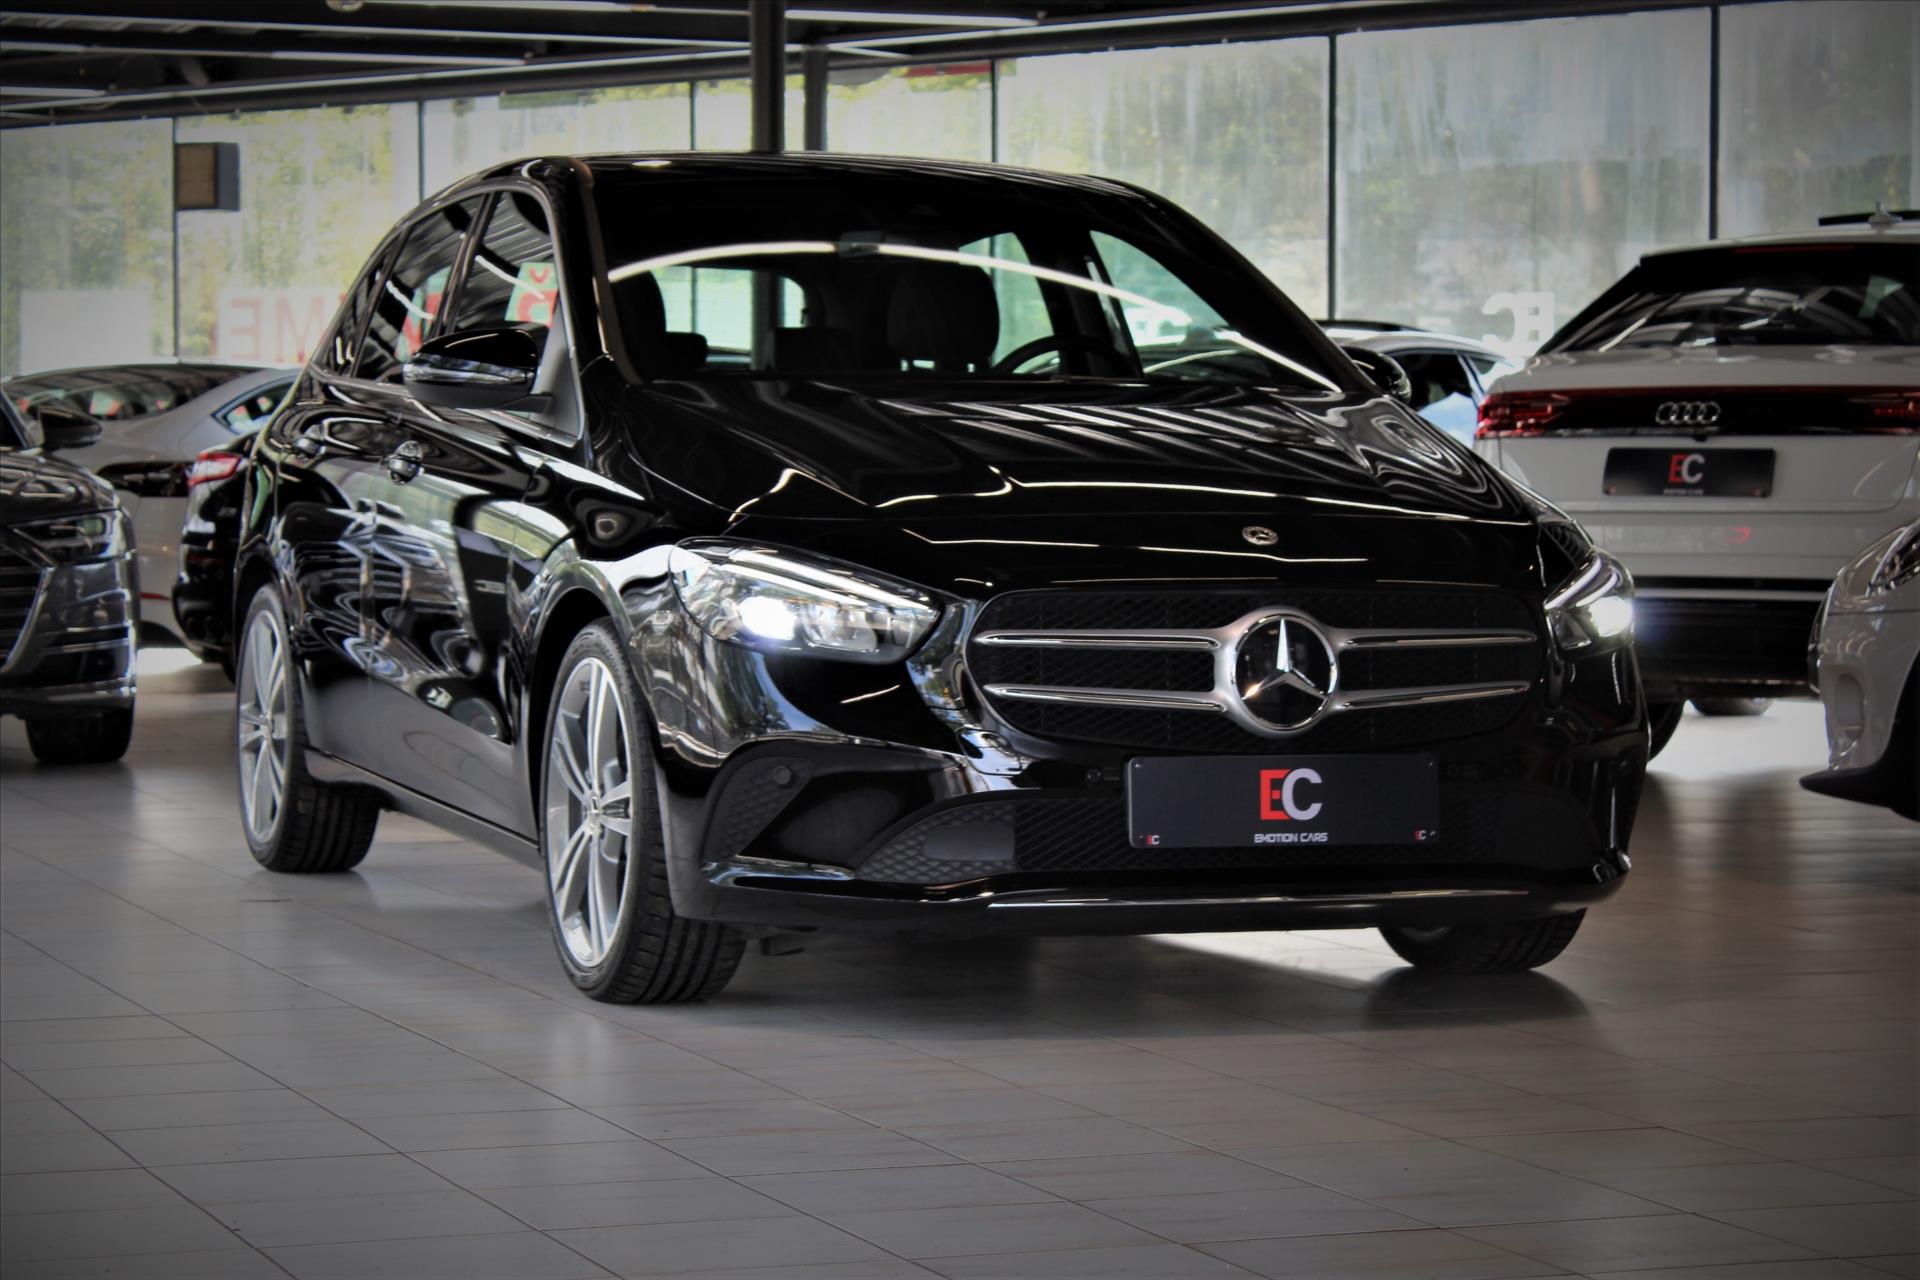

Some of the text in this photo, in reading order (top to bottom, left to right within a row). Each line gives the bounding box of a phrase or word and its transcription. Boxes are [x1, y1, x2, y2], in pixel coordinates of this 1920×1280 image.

[1668, 453, 1705, 484] EC
[1259, 768, 1323, 821] EC
[1253, 832, 1328, 843] EMOTION CARS
